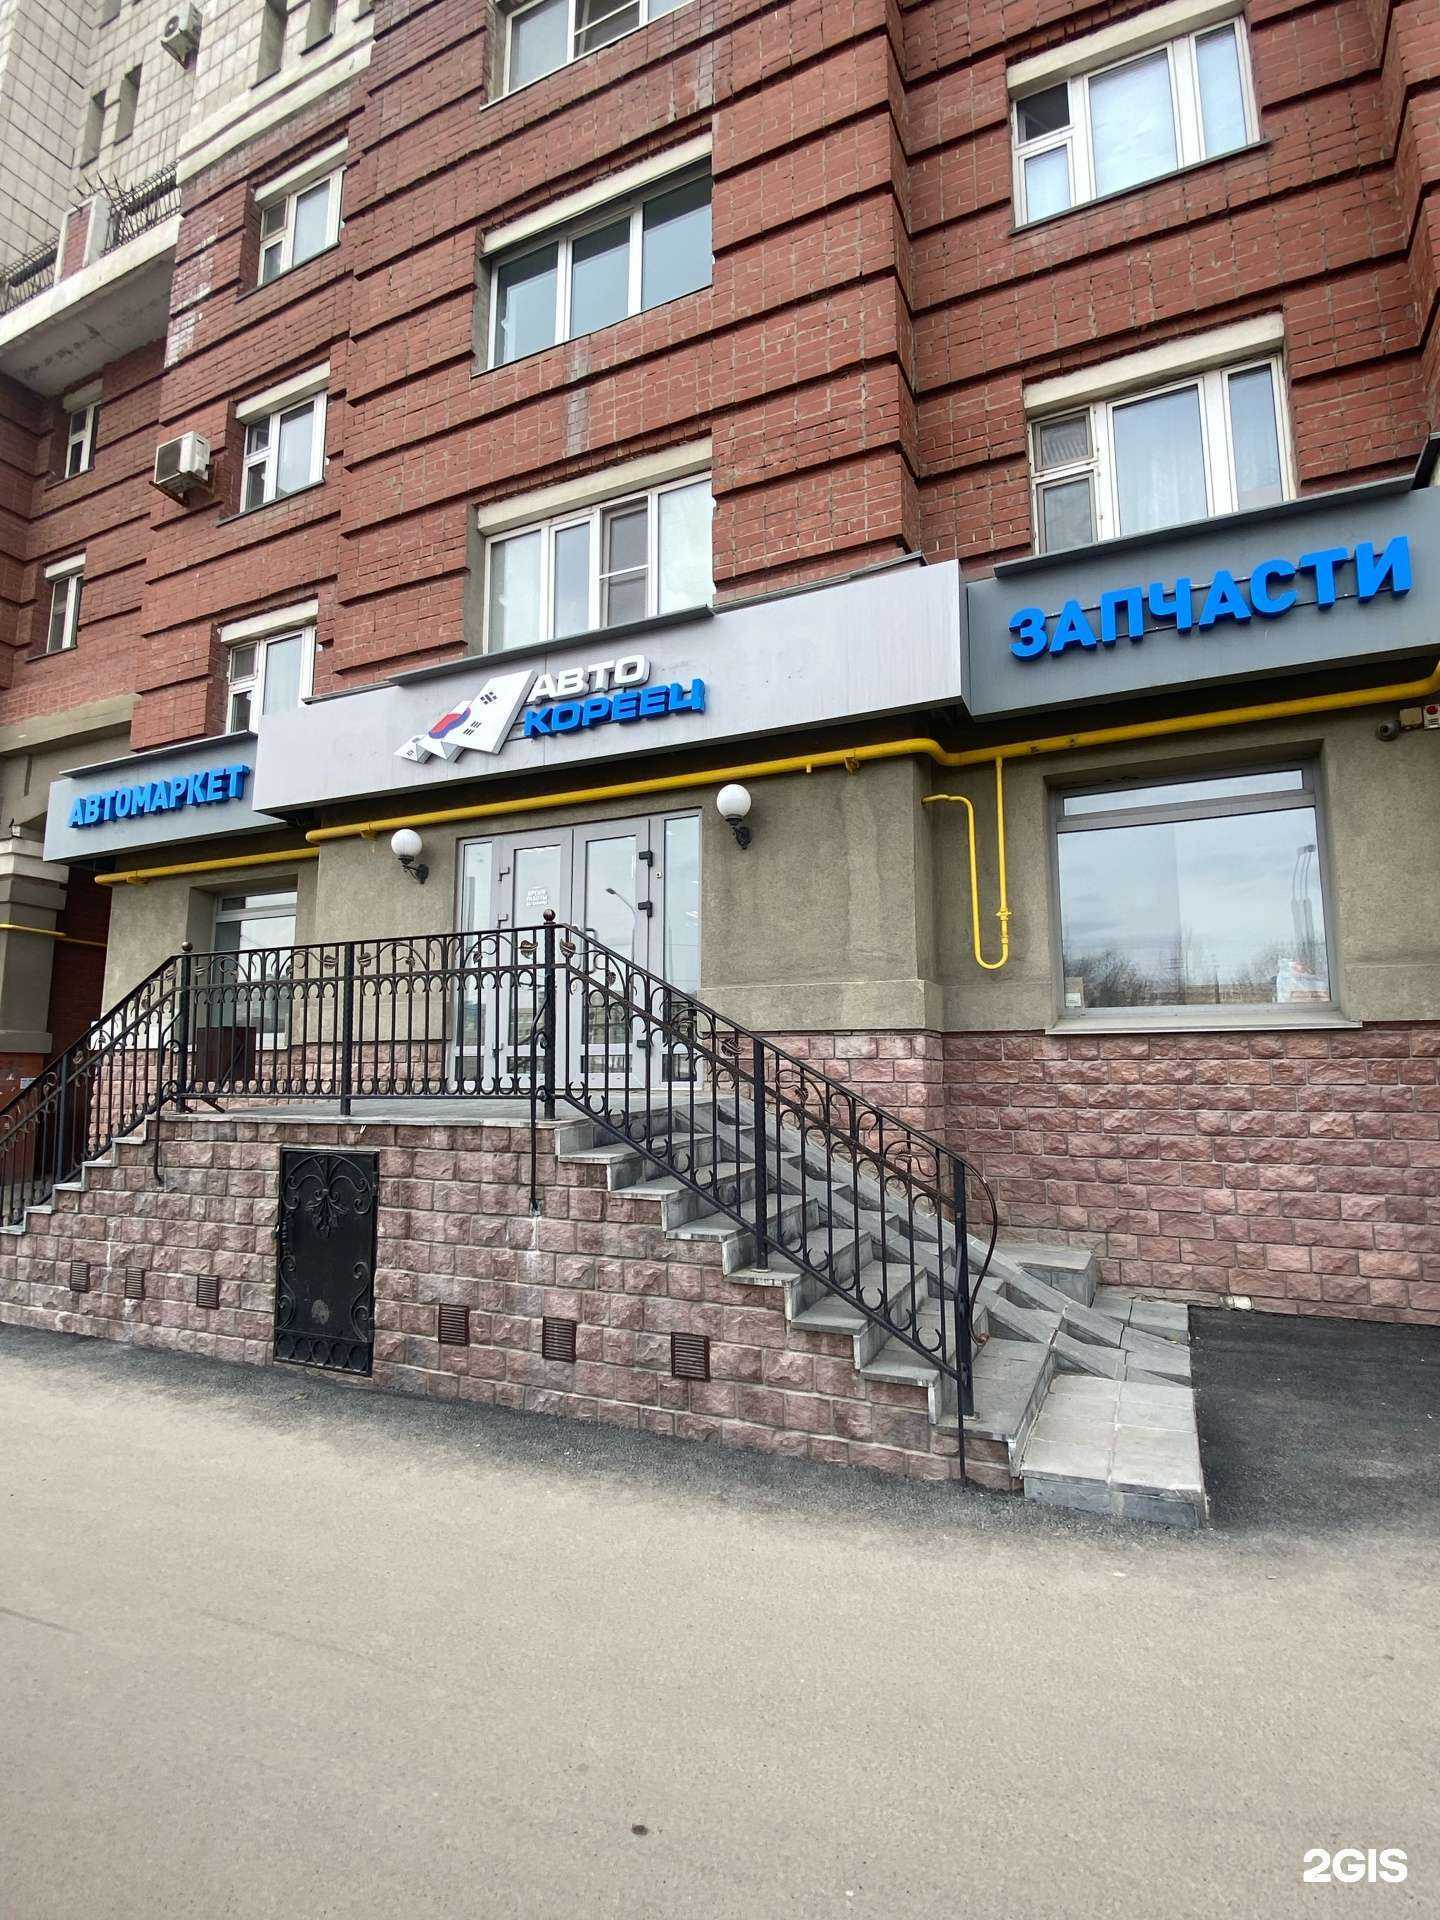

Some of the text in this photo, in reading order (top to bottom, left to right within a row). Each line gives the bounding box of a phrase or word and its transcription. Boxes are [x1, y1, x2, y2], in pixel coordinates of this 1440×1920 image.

[1009, 536, 1412, 661] ЗАПЧАСТИ
[523, 678, 705, 738] КОРЕЕЦ
[526, 655, 650, 702] АВТО
[69, 764, 250, 828] АВТОМАРКЕТ
